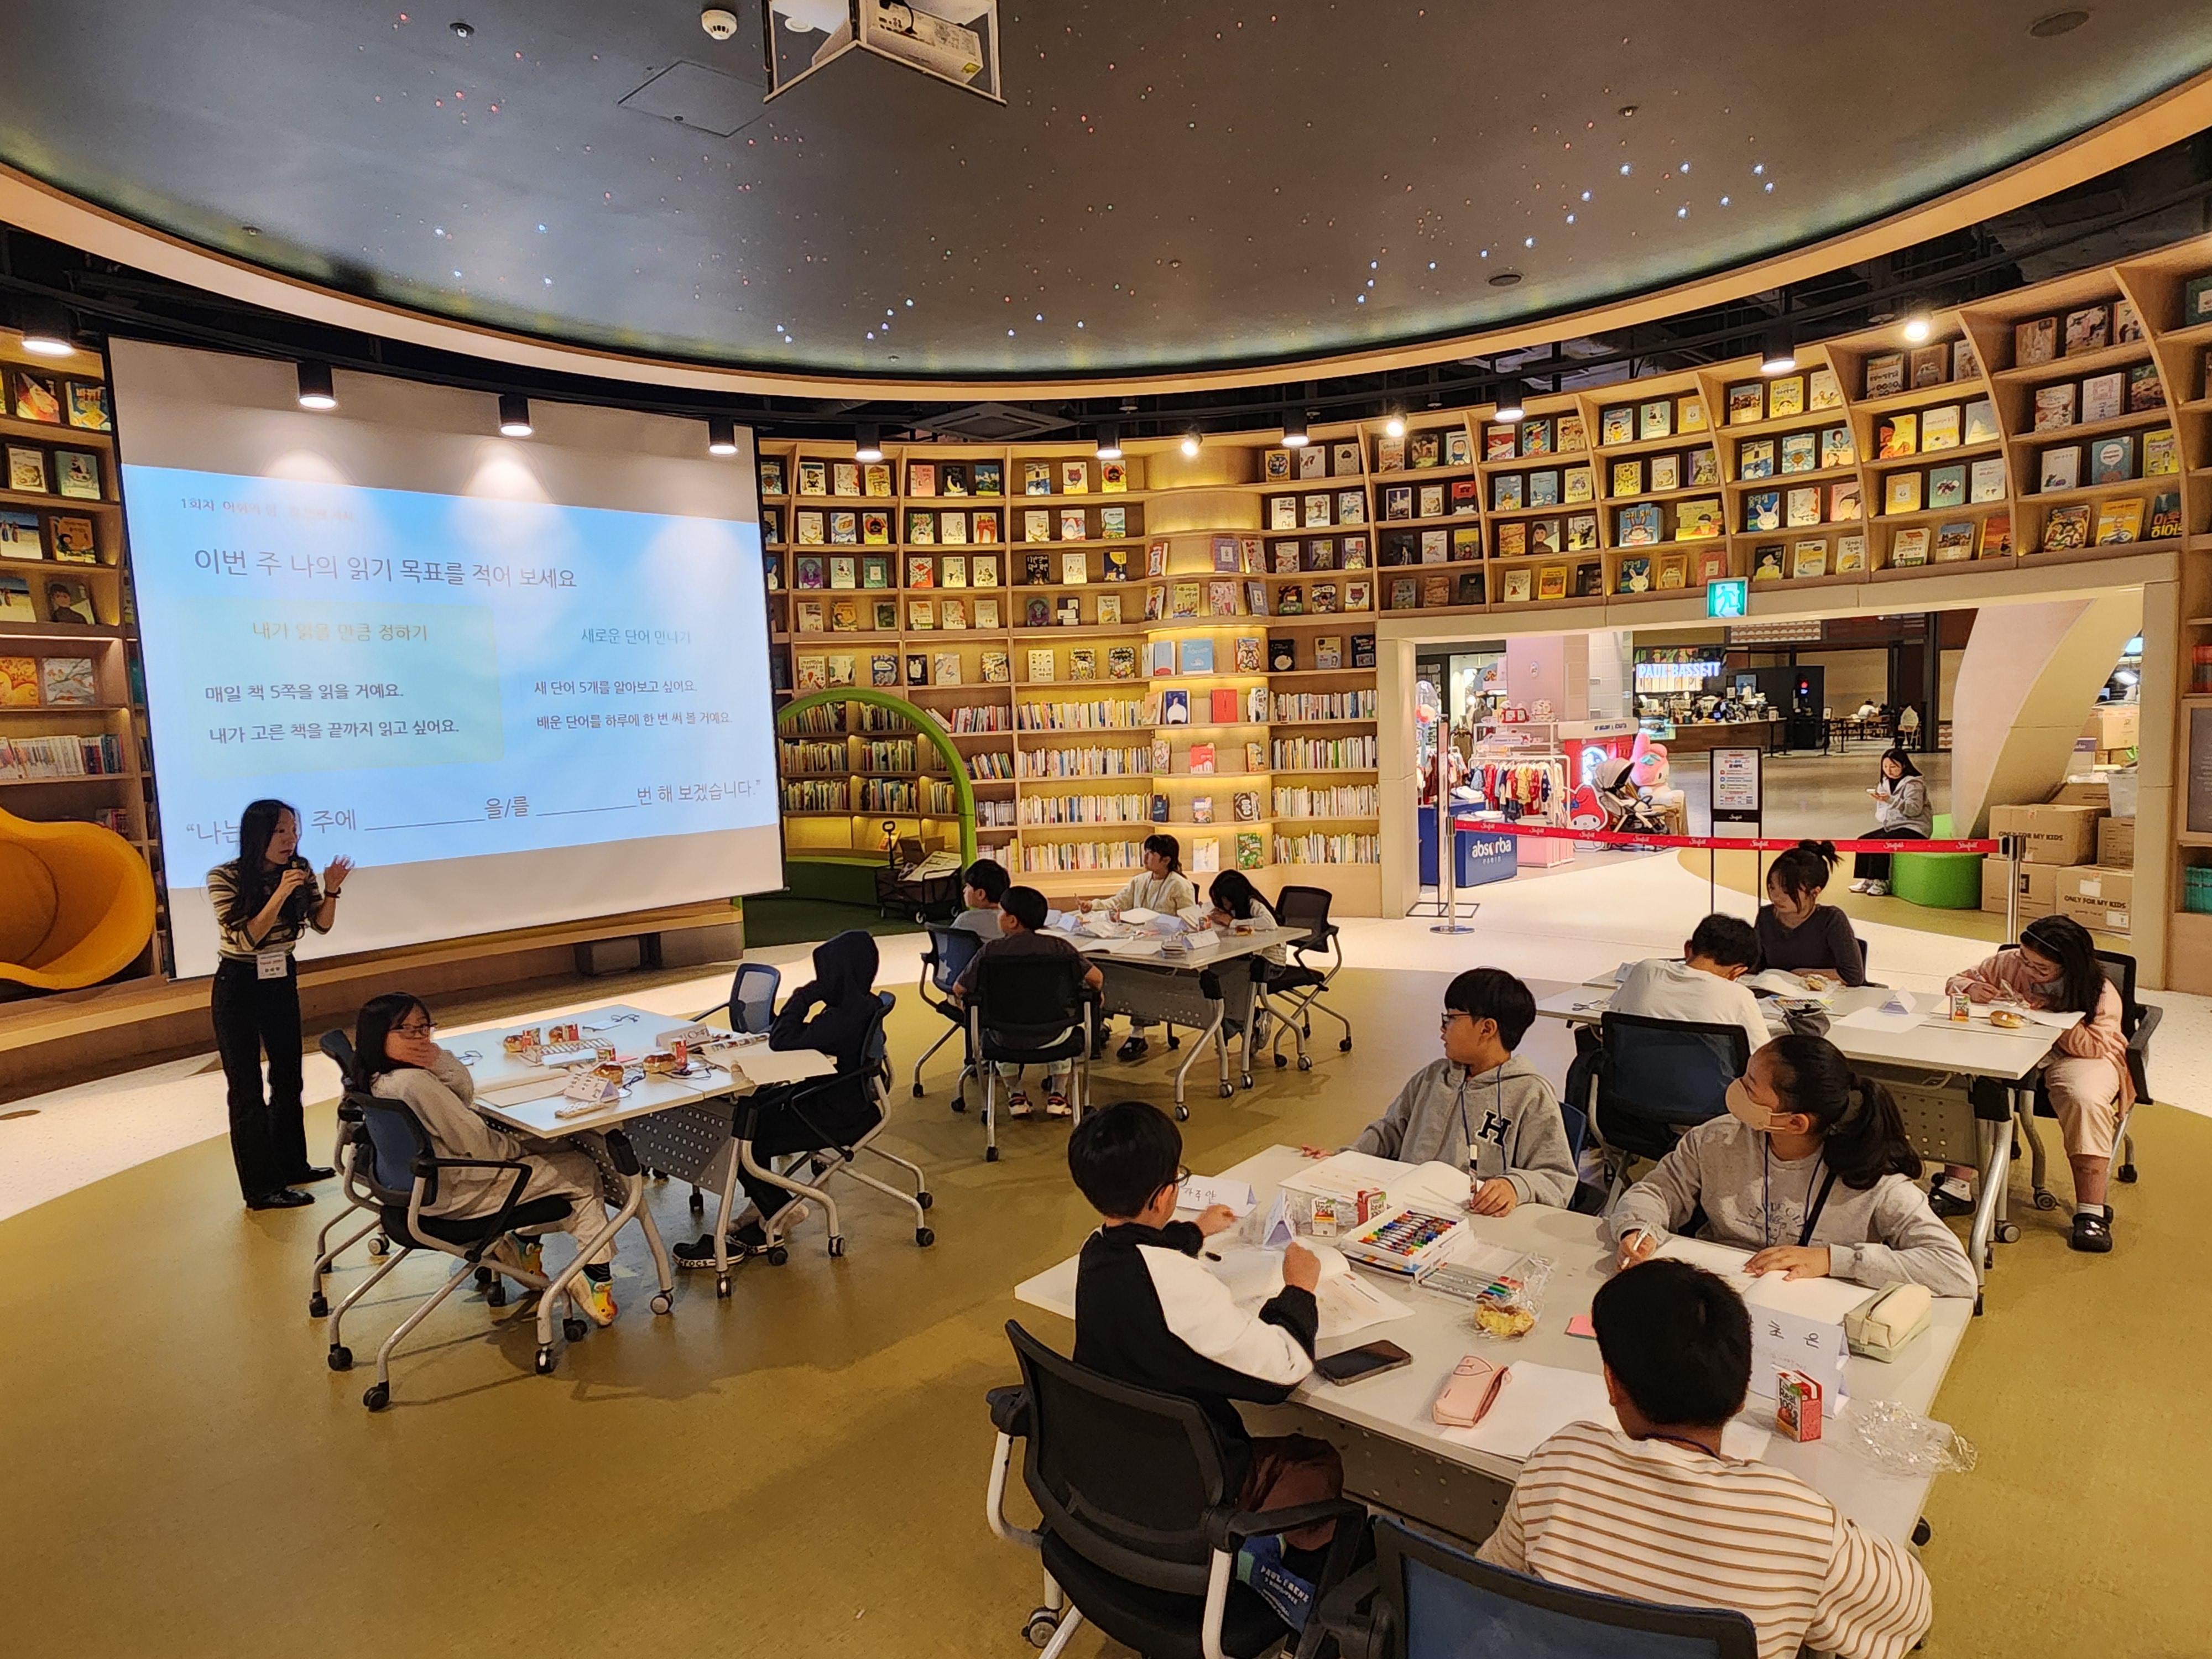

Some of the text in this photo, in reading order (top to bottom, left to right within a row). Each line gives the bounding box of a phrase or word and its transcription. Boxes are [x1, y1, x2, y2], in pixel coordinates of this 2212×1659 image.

[195, 549, 577, 589] 이번 주 나의 읽기 목표를 적어 보세요
[253, 621, 427, 642] 내가 읽을 만큼 정하기
[581, 628, 621, 644] 새로운
[625, 629, 650, 645] 단어
[1638, 661, 1721, 679] PAUL BASSETT
[205, 683, 404, 703] 매일 책 5쪽을 읽을 거예요.
[534, 681, 547, 696] 새
[551, 681, 575, 696] 단어
[579, 680, 611, 695] 5개를
[614, 680, 660, 695] 알아보고
[536, 711, 733, 730] 배운 단어를 하루에 한 번 써 볼 거예요.
[210, 719, 460, 744] 내가 고른 책을 끝까지 읽고 싶어요.
[311, 808, 357, 834] 주에
[484, 795, 530, 820] 을/를
[637, 787, 653, 806] 번
[658, 784, 673, 803] 해
[2064, 895, 2081, 903] ONLY
[2083, 897, 2096, 905] FOR
[2109, 901, 2126, 909] KIDS
[1477, 1110, 1512, 1147] H
[1779, 1389, 1796, 1405] Real
